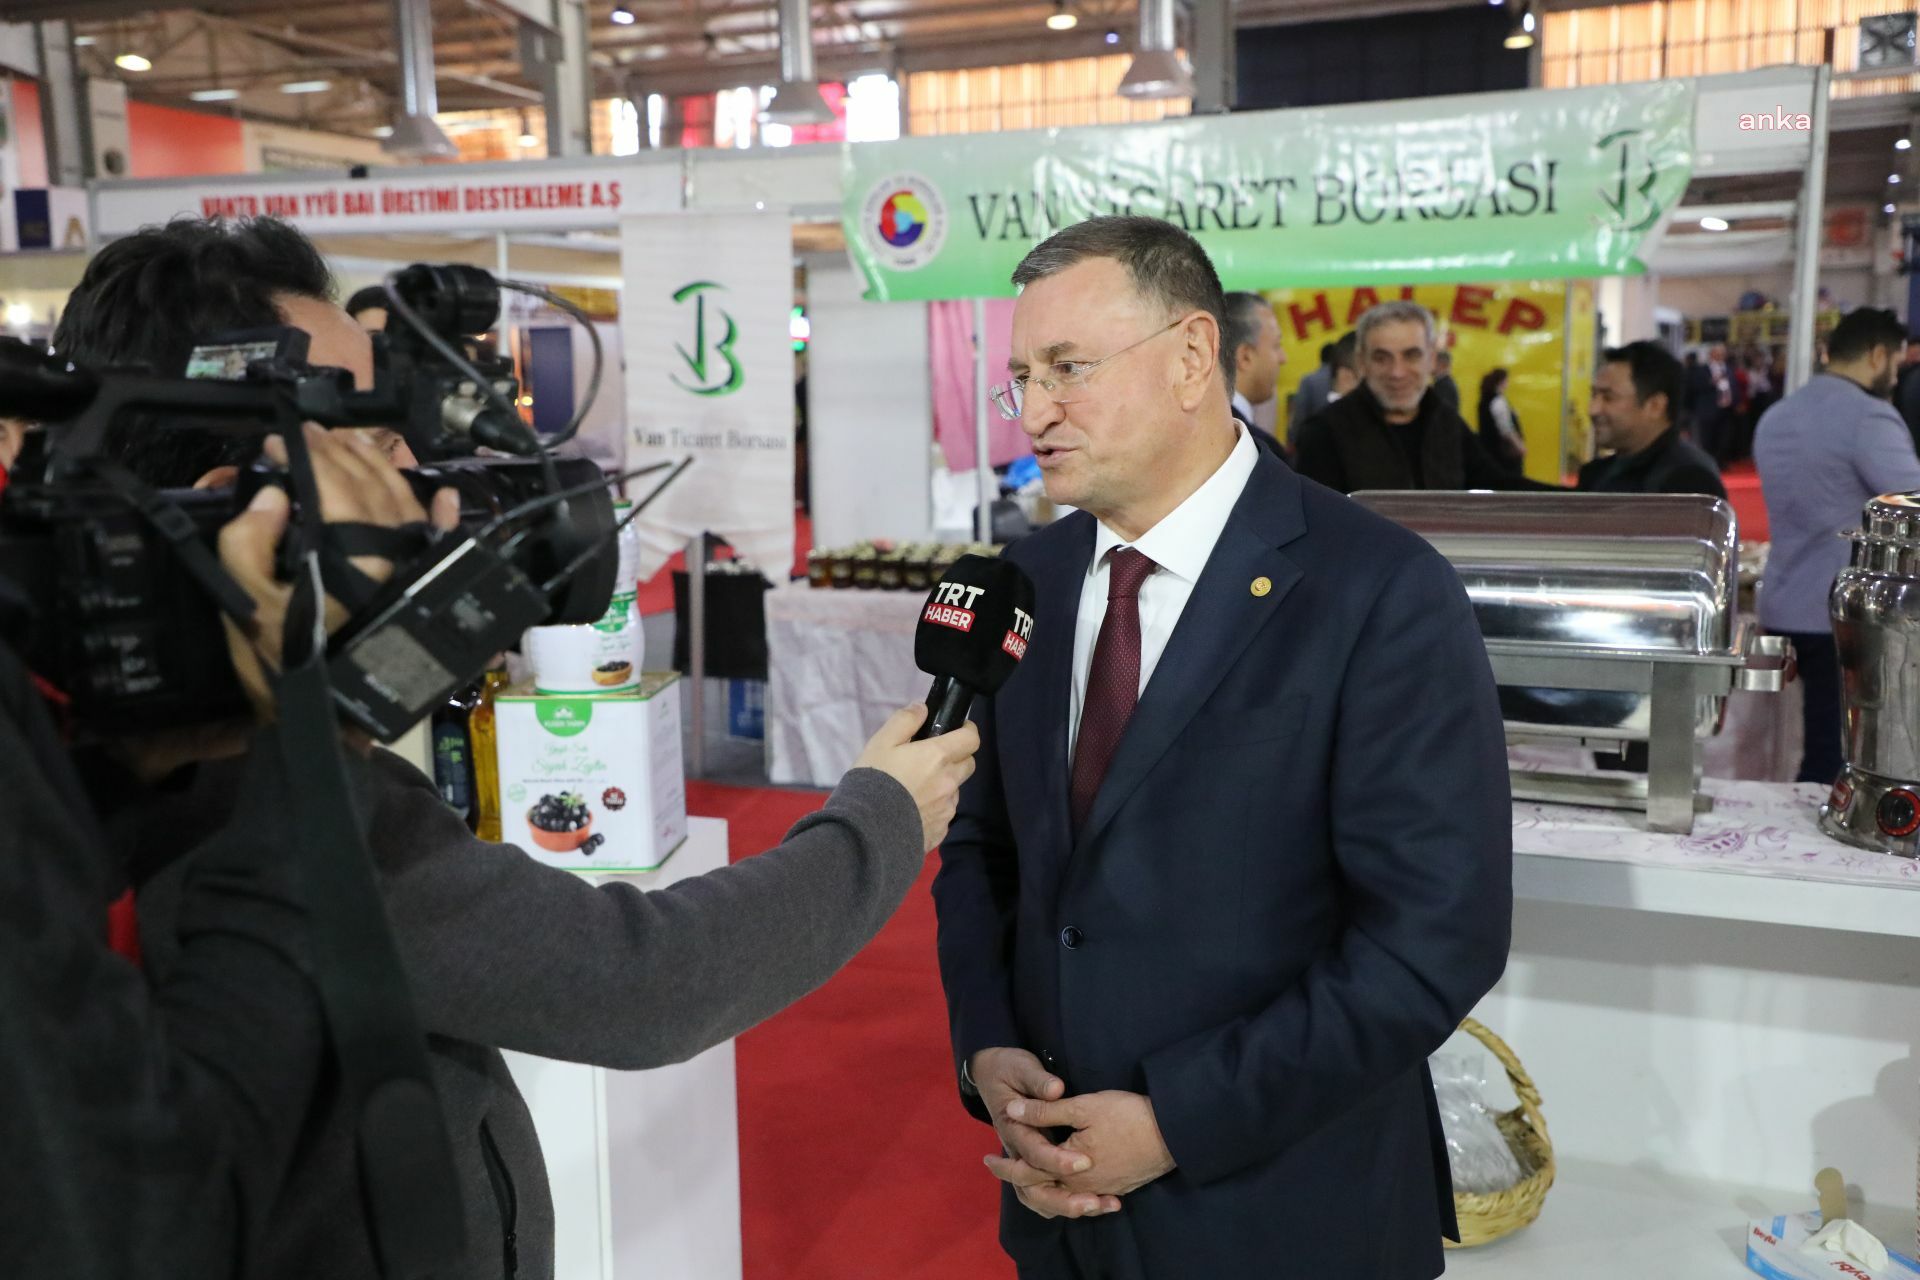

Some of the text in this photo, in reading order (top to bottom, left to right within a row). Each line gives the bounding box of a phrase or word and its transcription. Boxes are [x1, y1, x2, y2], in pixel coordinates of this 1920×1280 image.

[464, 183, 585, 212] DESTEKLEME
[967, 188, 1062, 241] VAN
[633, 427, 666, 447] Van
[670, 427, 722, 448] Ticaret
[935, 581, 986, 610] TRT
[924, 605, 972, 629] HABER
